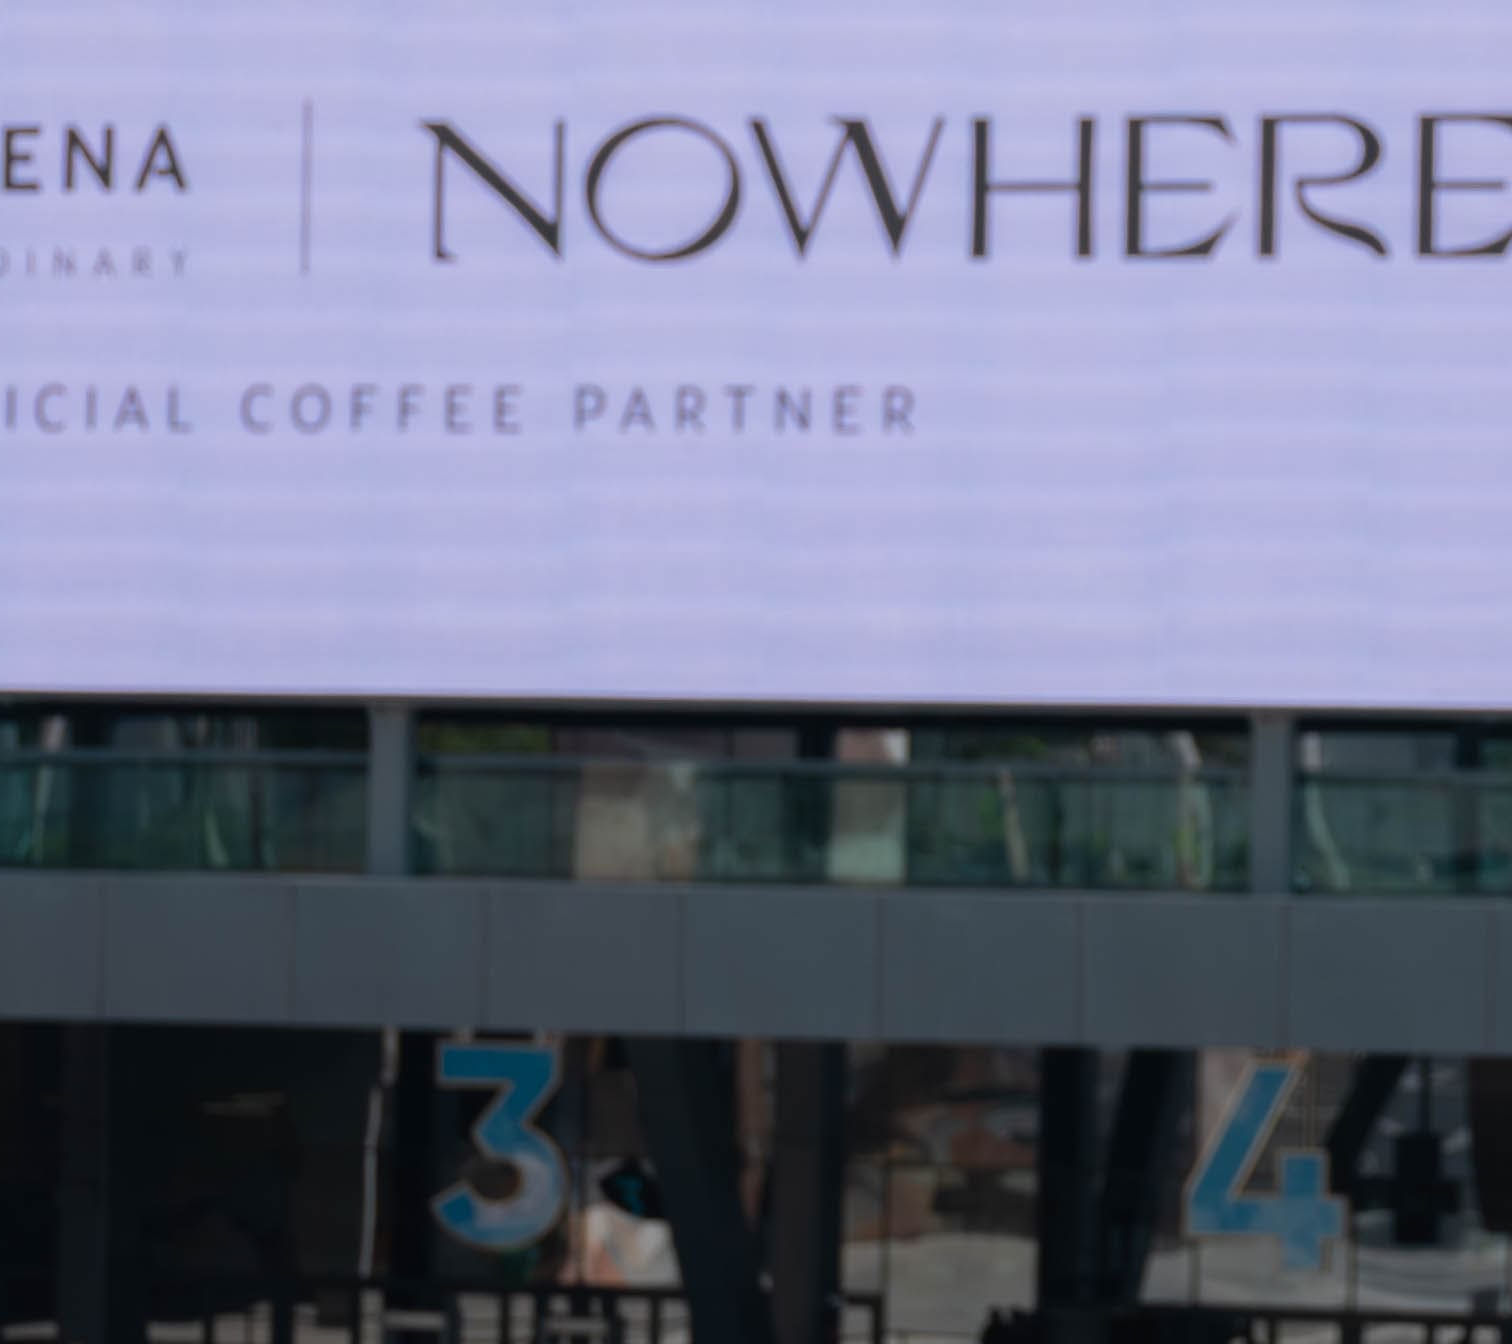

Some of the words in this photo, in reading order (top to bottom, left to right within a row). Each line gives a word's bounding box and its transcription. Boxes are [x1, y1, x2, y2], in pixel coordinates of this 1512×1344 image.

[239, 382, 524, 436] COFFEE
[573, 383, 917, 436] PARTNER
[430, 1040, 569, 1251] 3
[1183, 1058, 1350, 1270] 4
